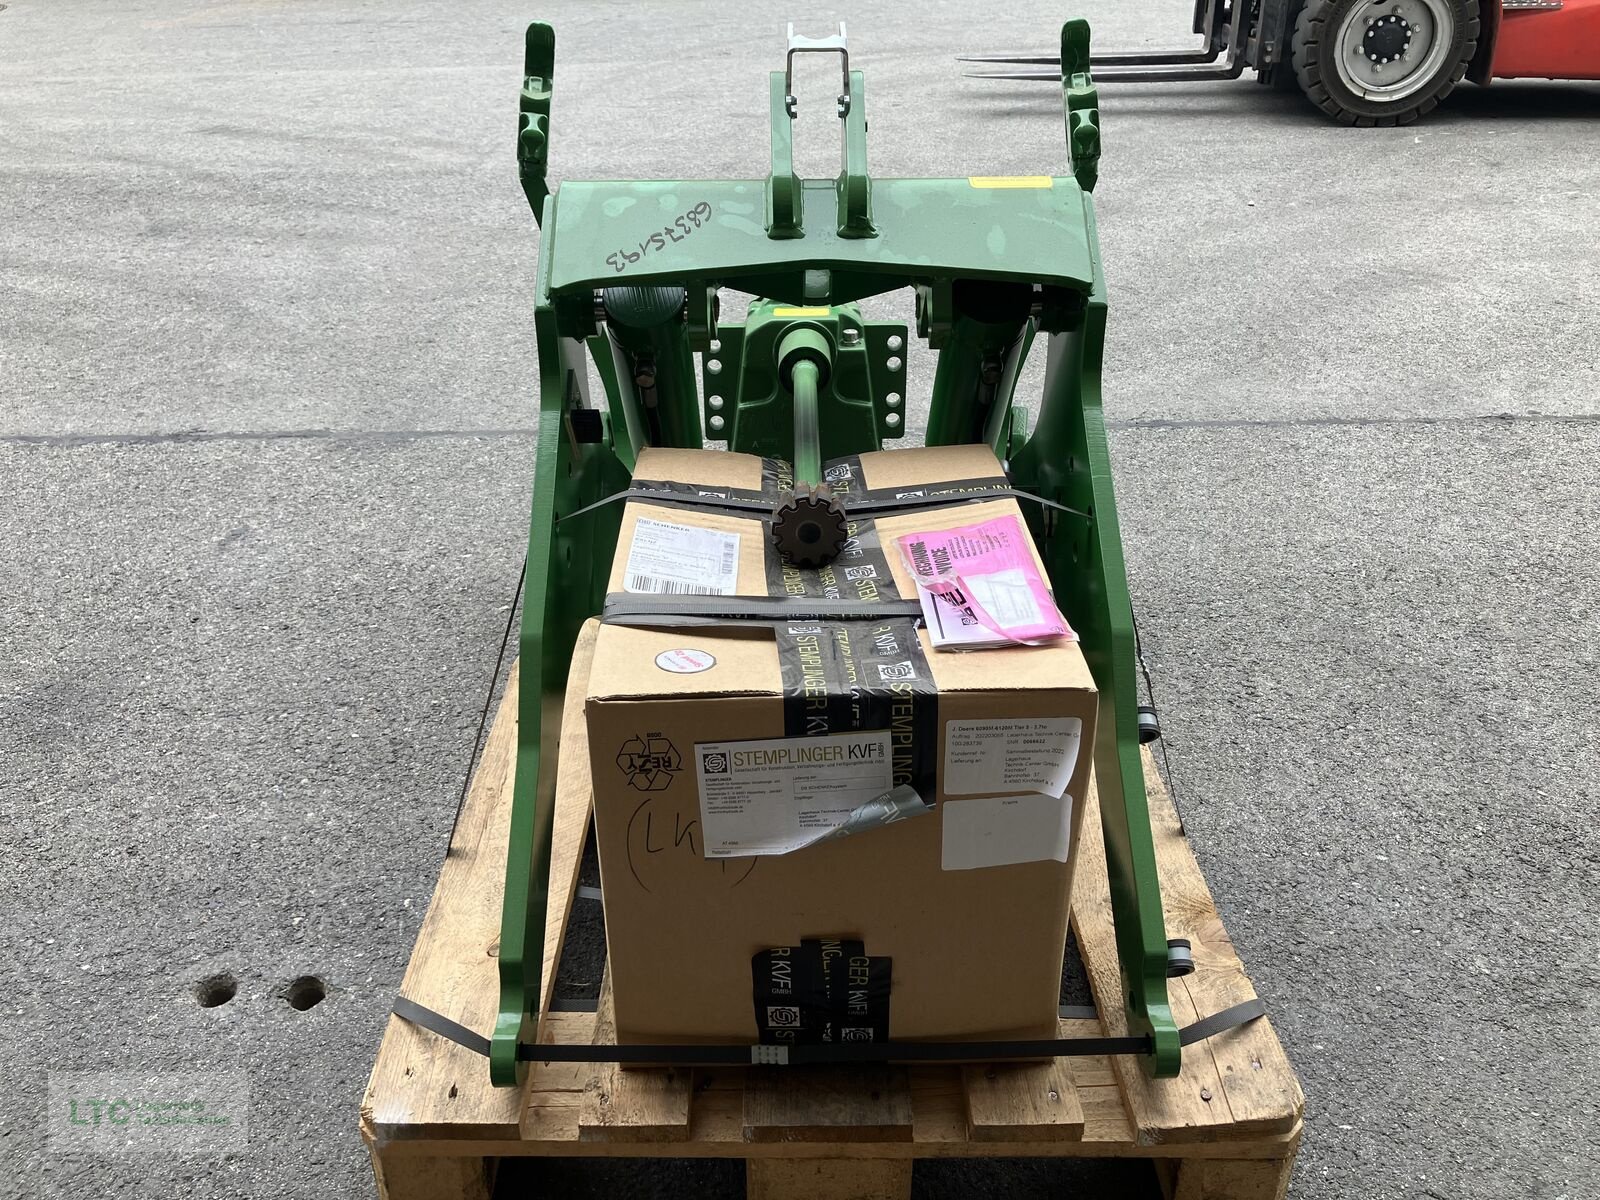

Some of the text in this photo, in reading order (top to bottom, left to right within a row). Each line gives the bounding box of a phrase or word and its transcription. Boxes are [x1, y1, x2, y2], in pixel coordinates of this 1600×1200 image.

[874, 632, 899, 652] KVF
[796, 635, 829, 710] STEMPLINGER
[734, 745, 844, 766] STEMPLINGER
[848, 742, 878, 760] KVF
[770, 960, 792, 988] KVF
[848, 990, 868, 1011] KVF
